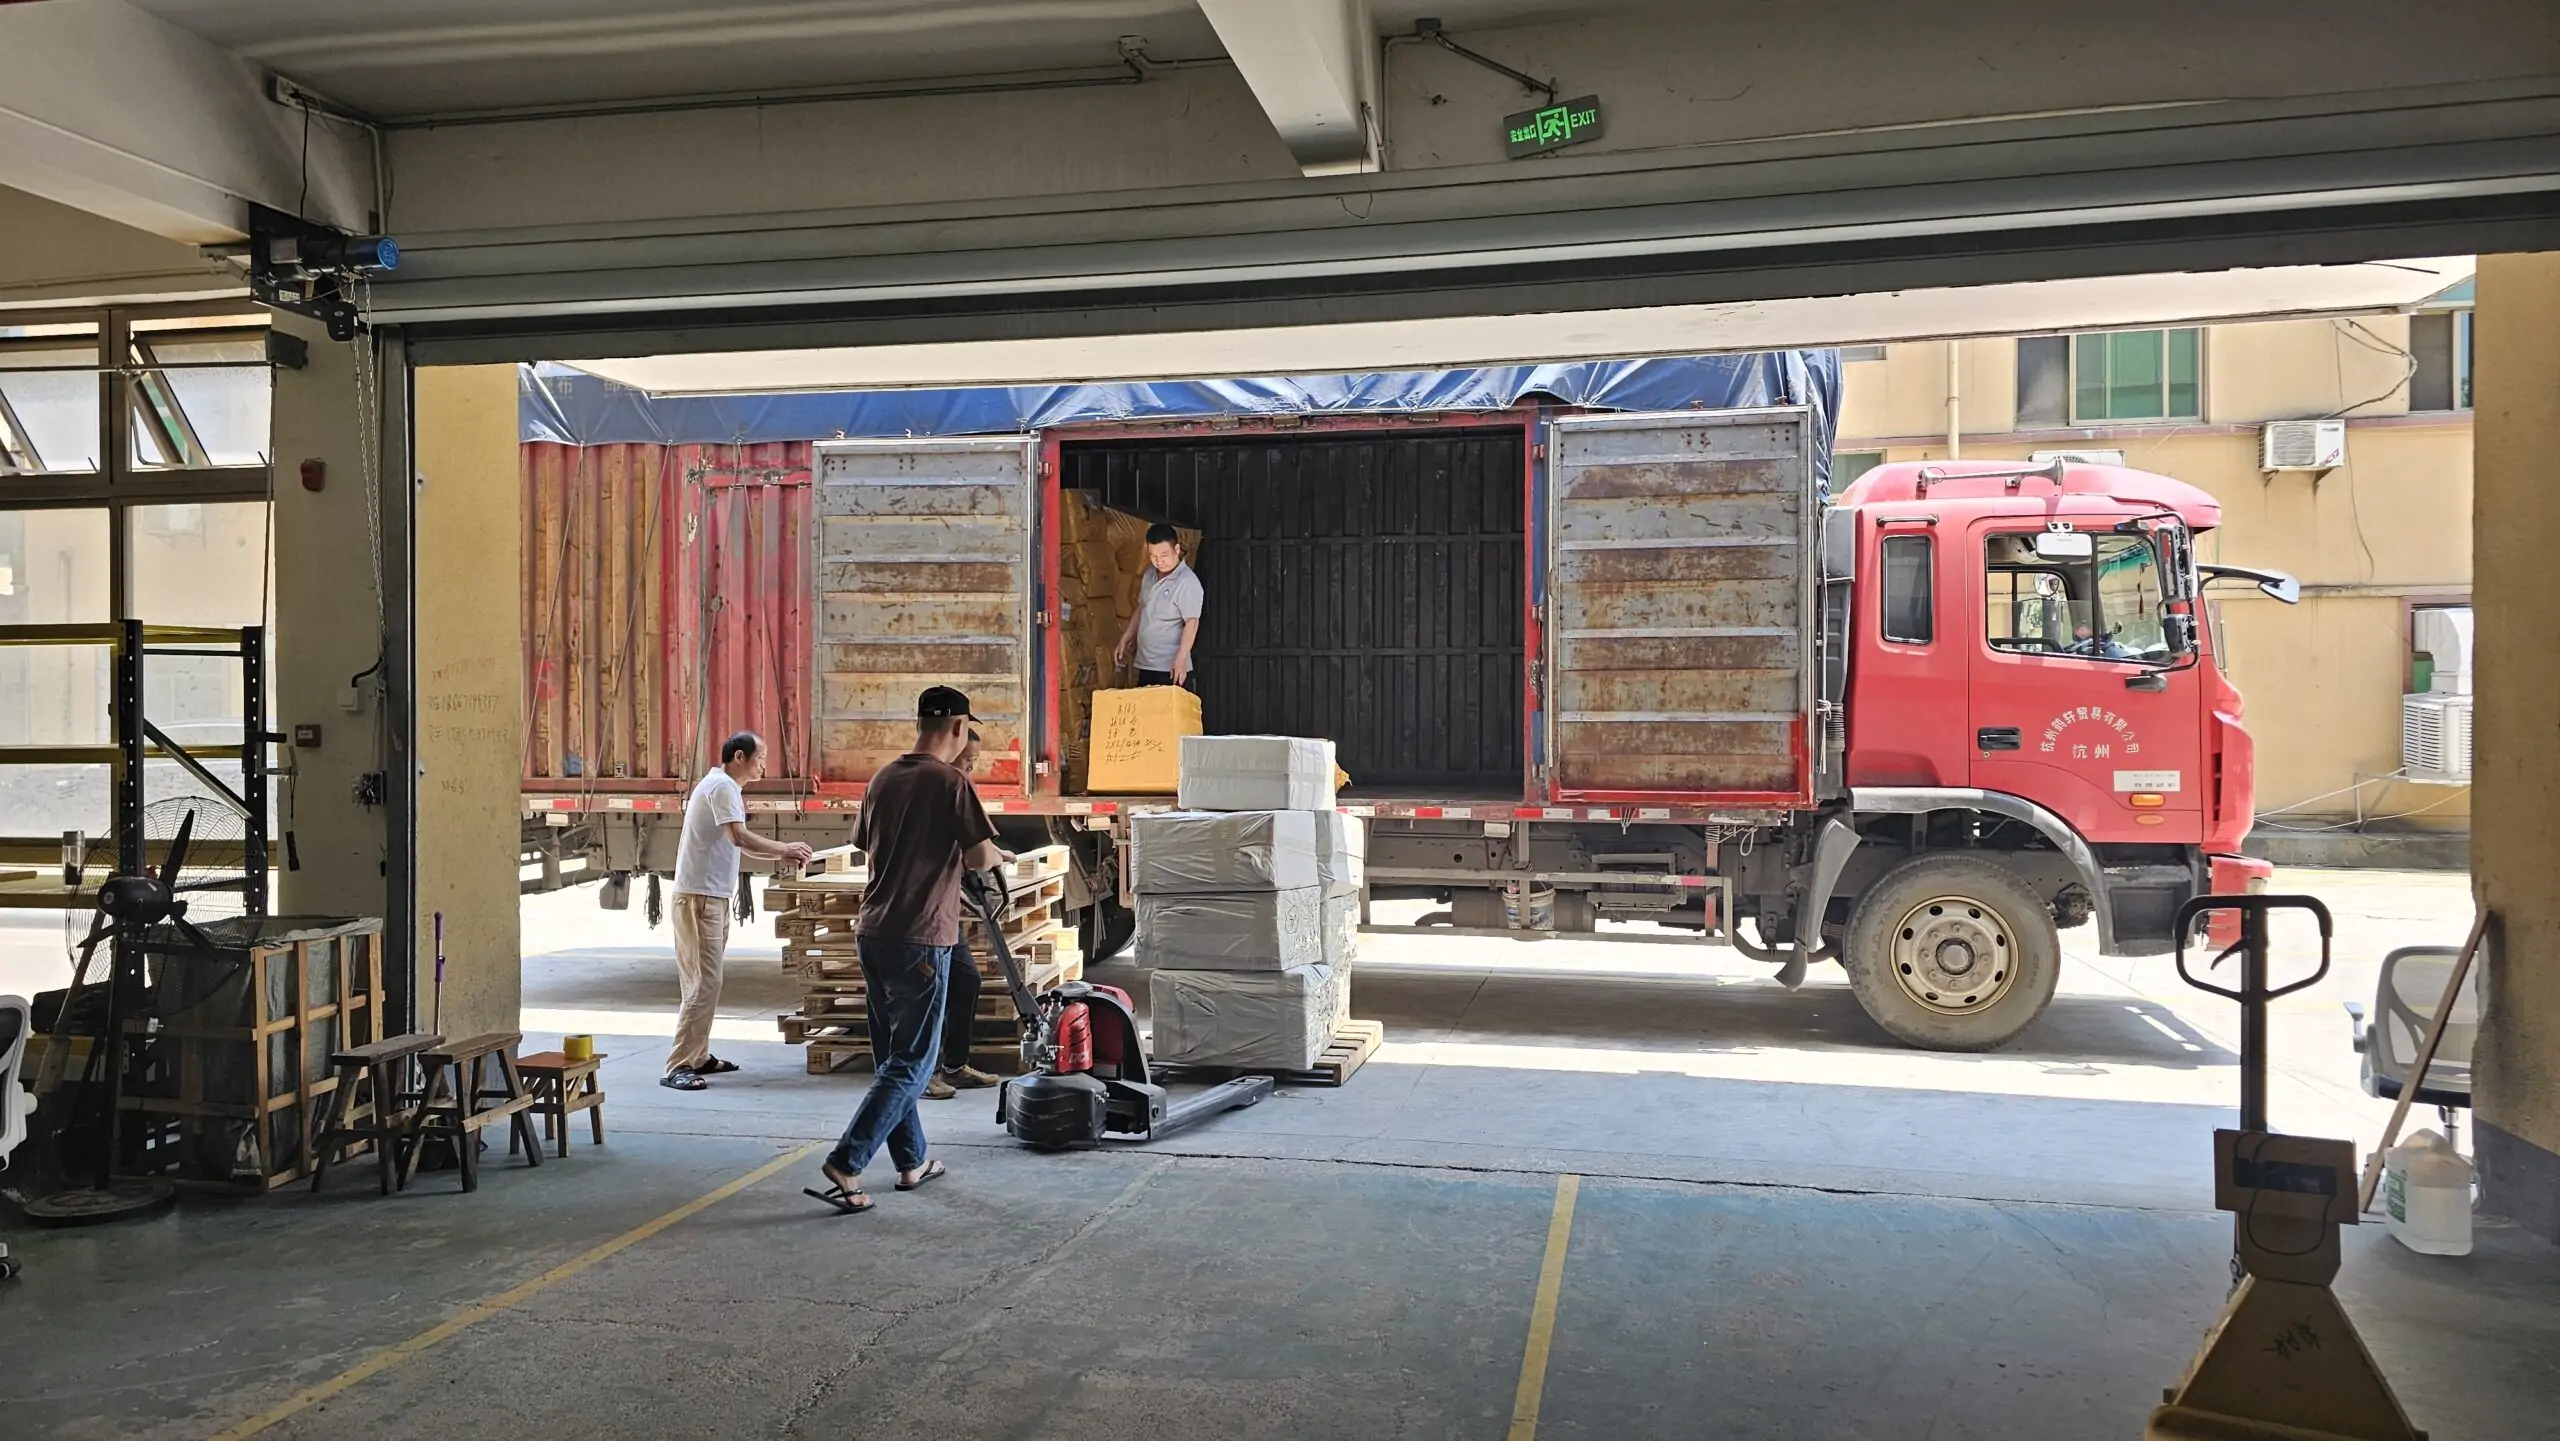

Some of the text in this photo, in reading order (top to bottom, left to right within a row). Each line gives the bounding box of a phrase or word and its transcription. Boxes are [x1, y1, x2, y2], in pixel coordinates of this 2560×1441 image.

[1570, 109, 1596, 128] EXIT
[1510, 124, 1537, 143] 安全出口
[2071, 744, 2110, 759] 杭州
